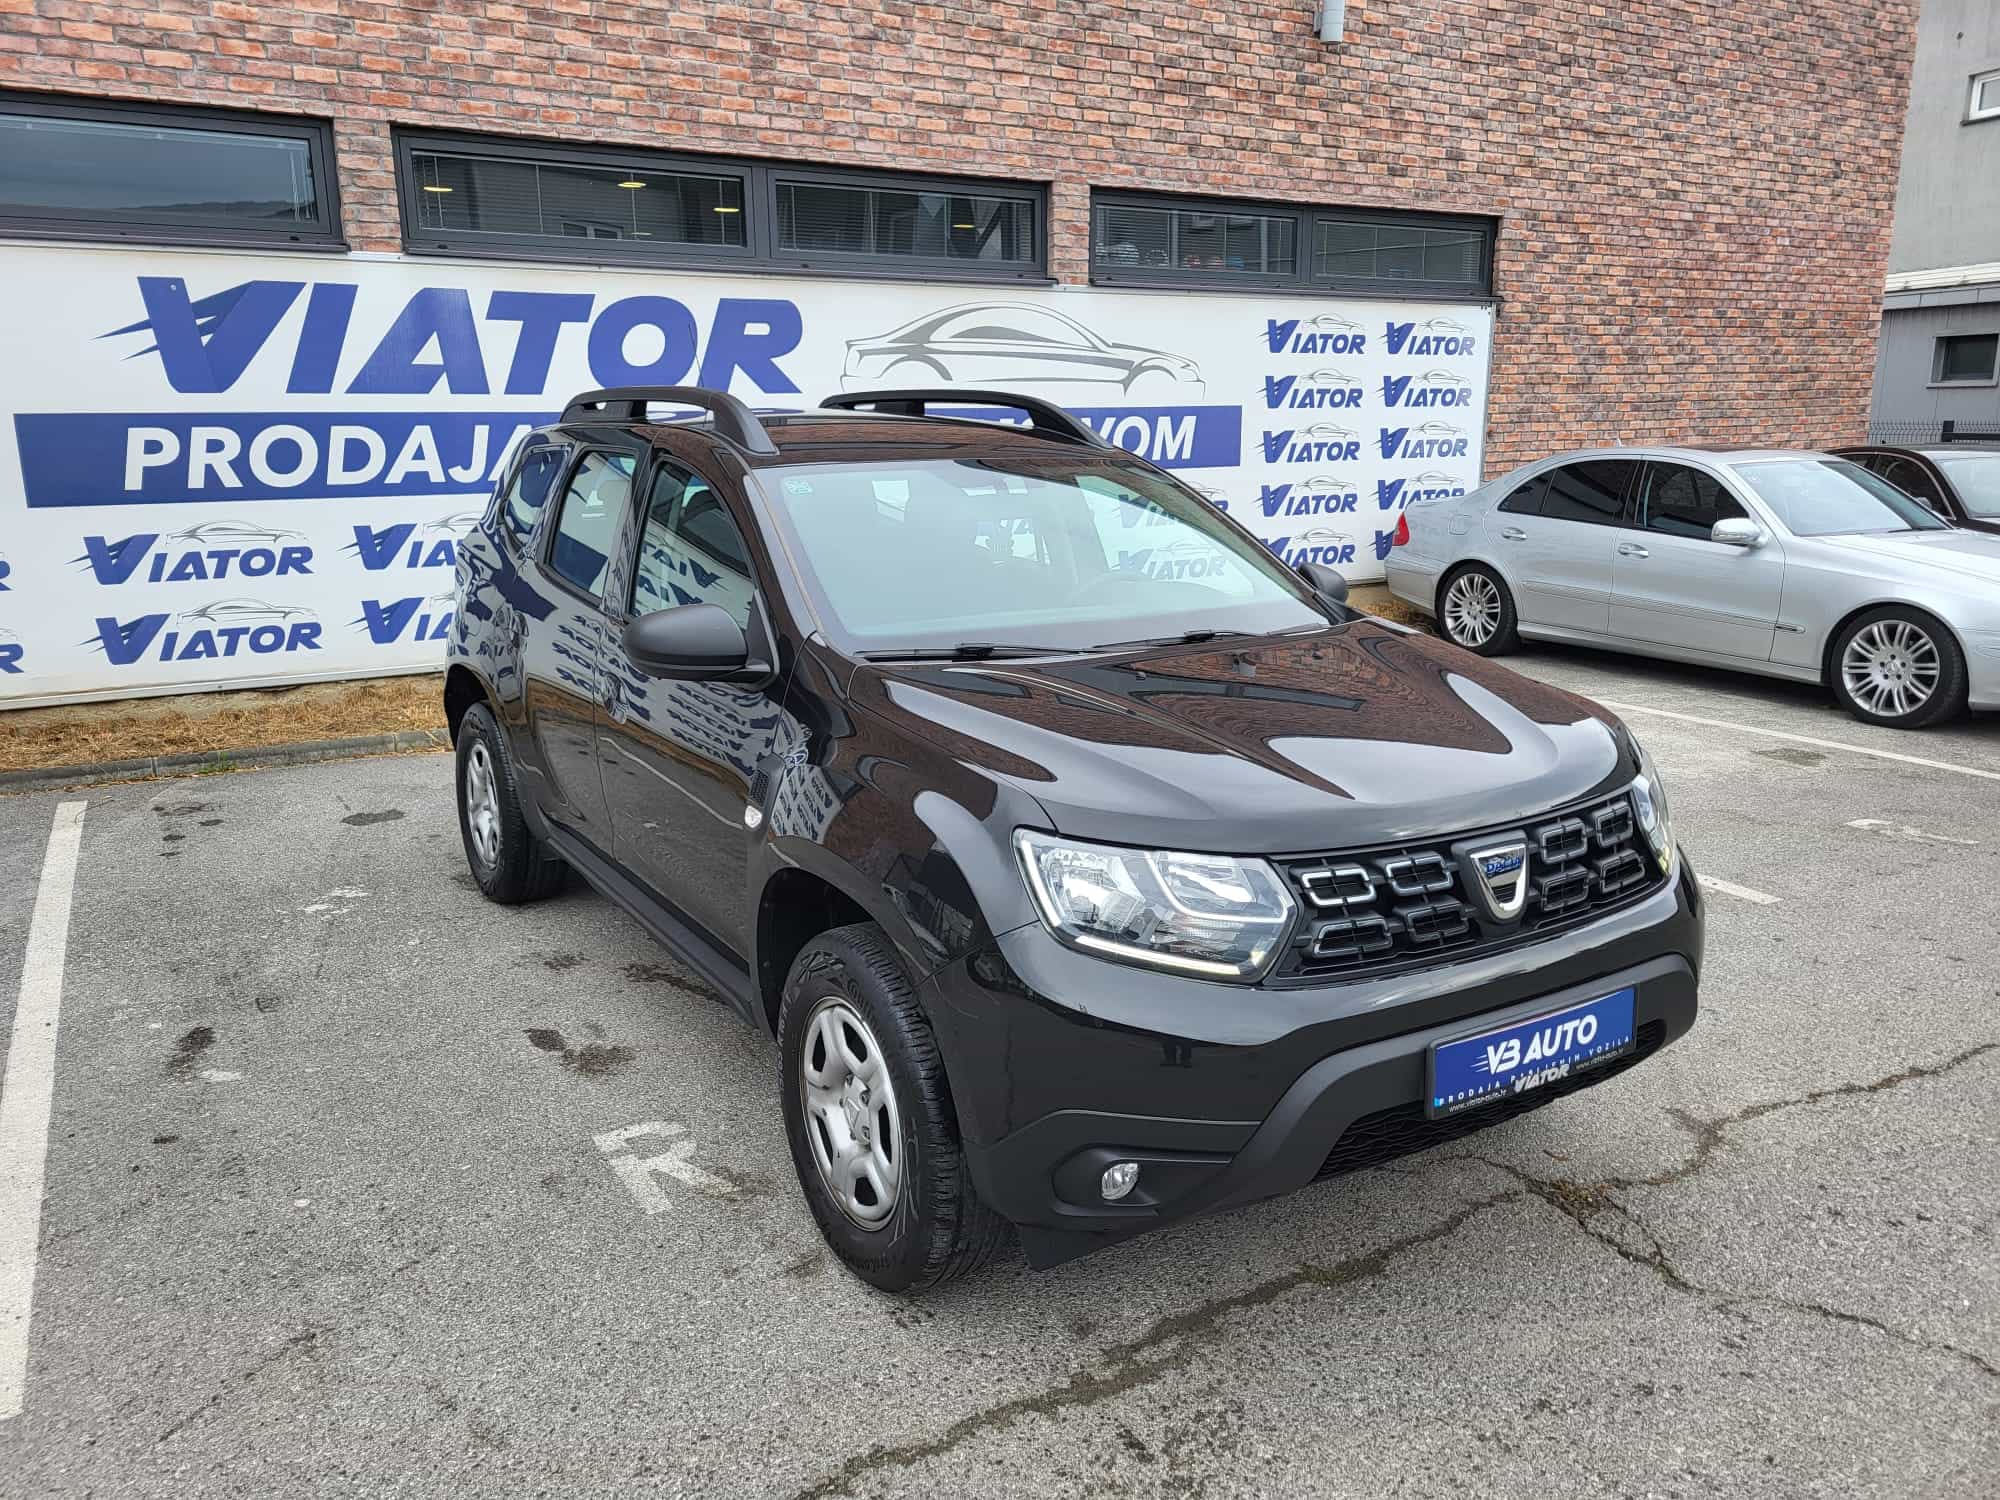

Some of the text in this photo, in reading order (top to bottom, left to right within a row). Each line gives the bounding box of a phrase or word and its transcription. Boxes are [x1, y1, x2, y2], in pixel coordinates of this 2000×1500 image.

[137, 276, 803, 395] VIATOR
[1267, 319, 1366, 355] VIATOR
[1386, 322, 1475, 356] VIATOR
[1265, 375, 1363, 409] VIATOR
[1383, 375, 1471, 408] VIATOR
[1263, 430, 1360, 464] VIATOR
[1380, 427, 1468, 460] VIATOR
[1261, 483, 1358, 517] VIATOR
[83, 534, 314, 585] VIATOR
[353, 523, 465, 570] VIA
[361, 597, 453, 644] VIA
[95, 613, 323, 665] VIATOR
[1522, 1014, 1598, 1065] AUTO
[1589, 1035, 1630, 1055] VOZILA
[1514, 1063, 1570, 1094] VIATOR
